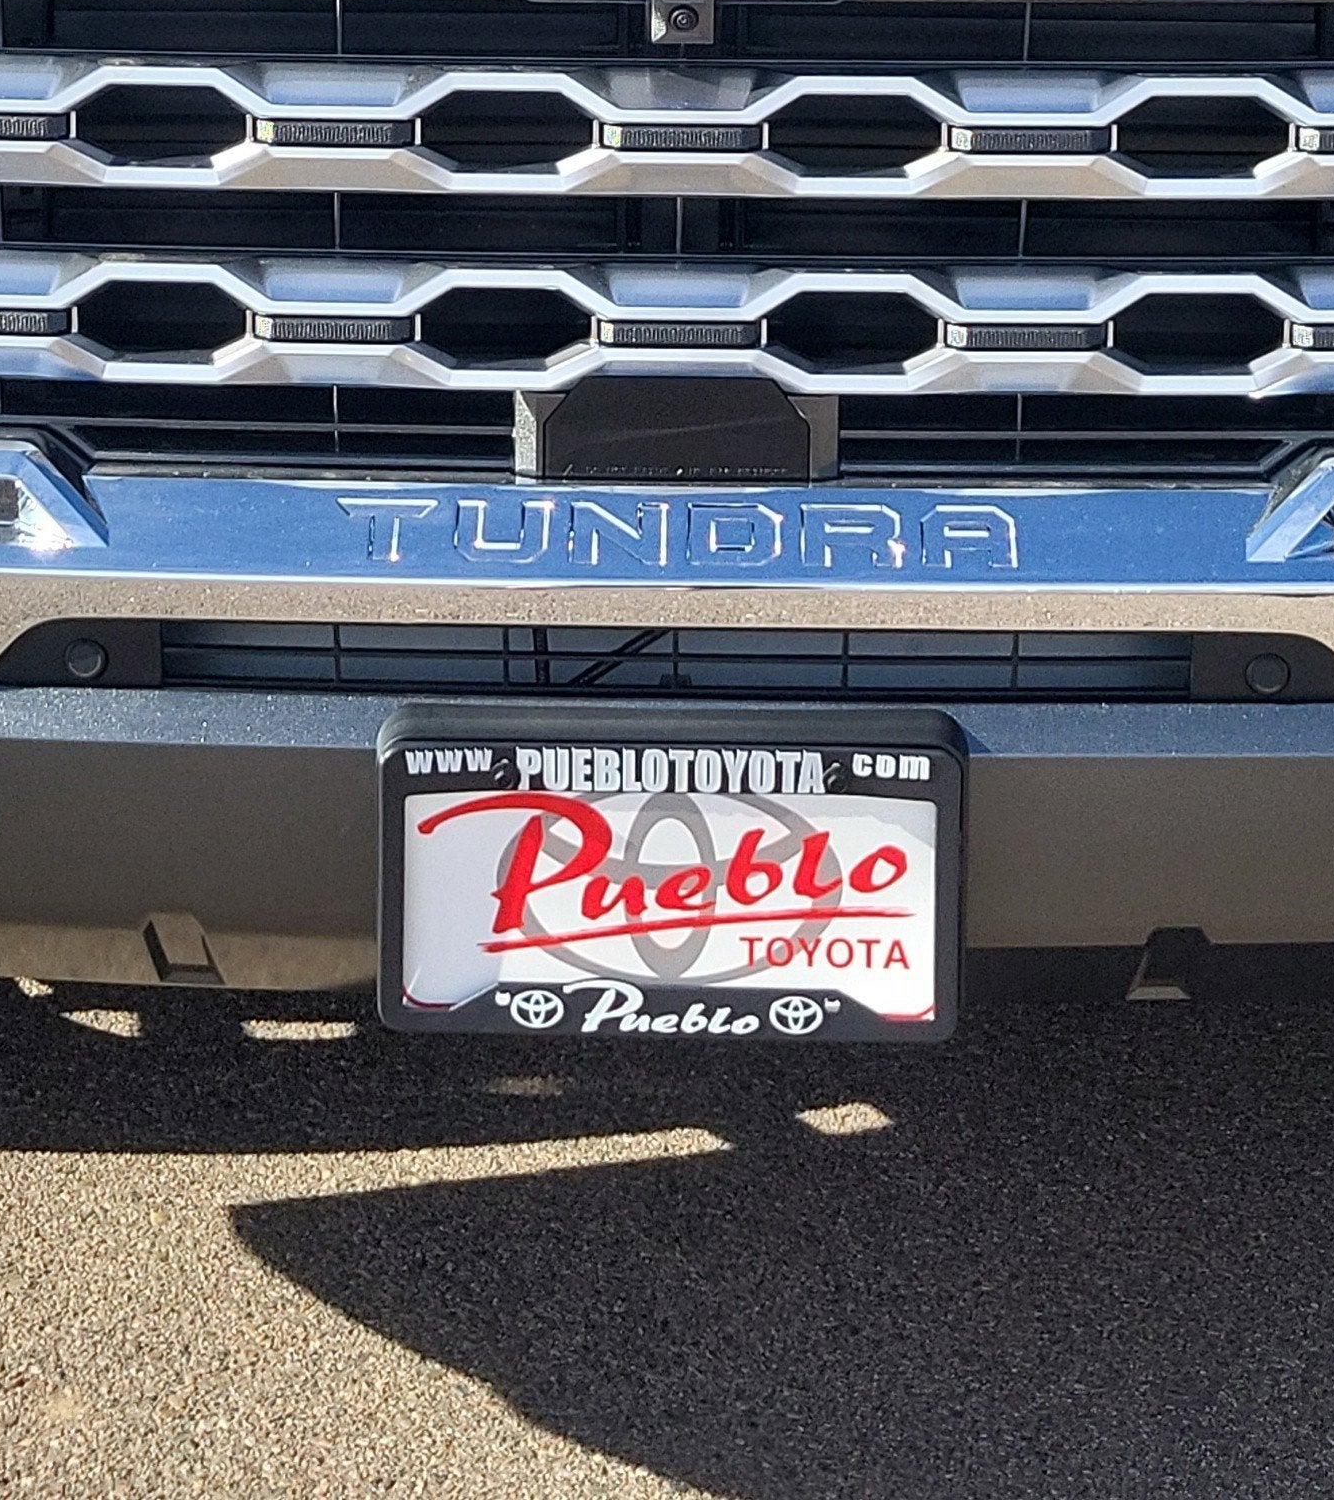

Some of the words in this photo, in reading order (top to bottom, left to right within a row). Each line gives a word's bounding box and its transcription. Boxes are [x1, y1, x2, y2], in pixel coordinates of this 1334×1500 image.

[336, 497, 1019, 568] TUNDRA
[405, 748, 493, 775] www
[516, 746, 825, 793] PUEBLOTOYOTA
[852, 753, 931, 781] com
[418, 791, 908, 933] Pueblo
[740, 936, 910, 971] TOYOTA
[562, 977, 760, 1035] Pueblo
